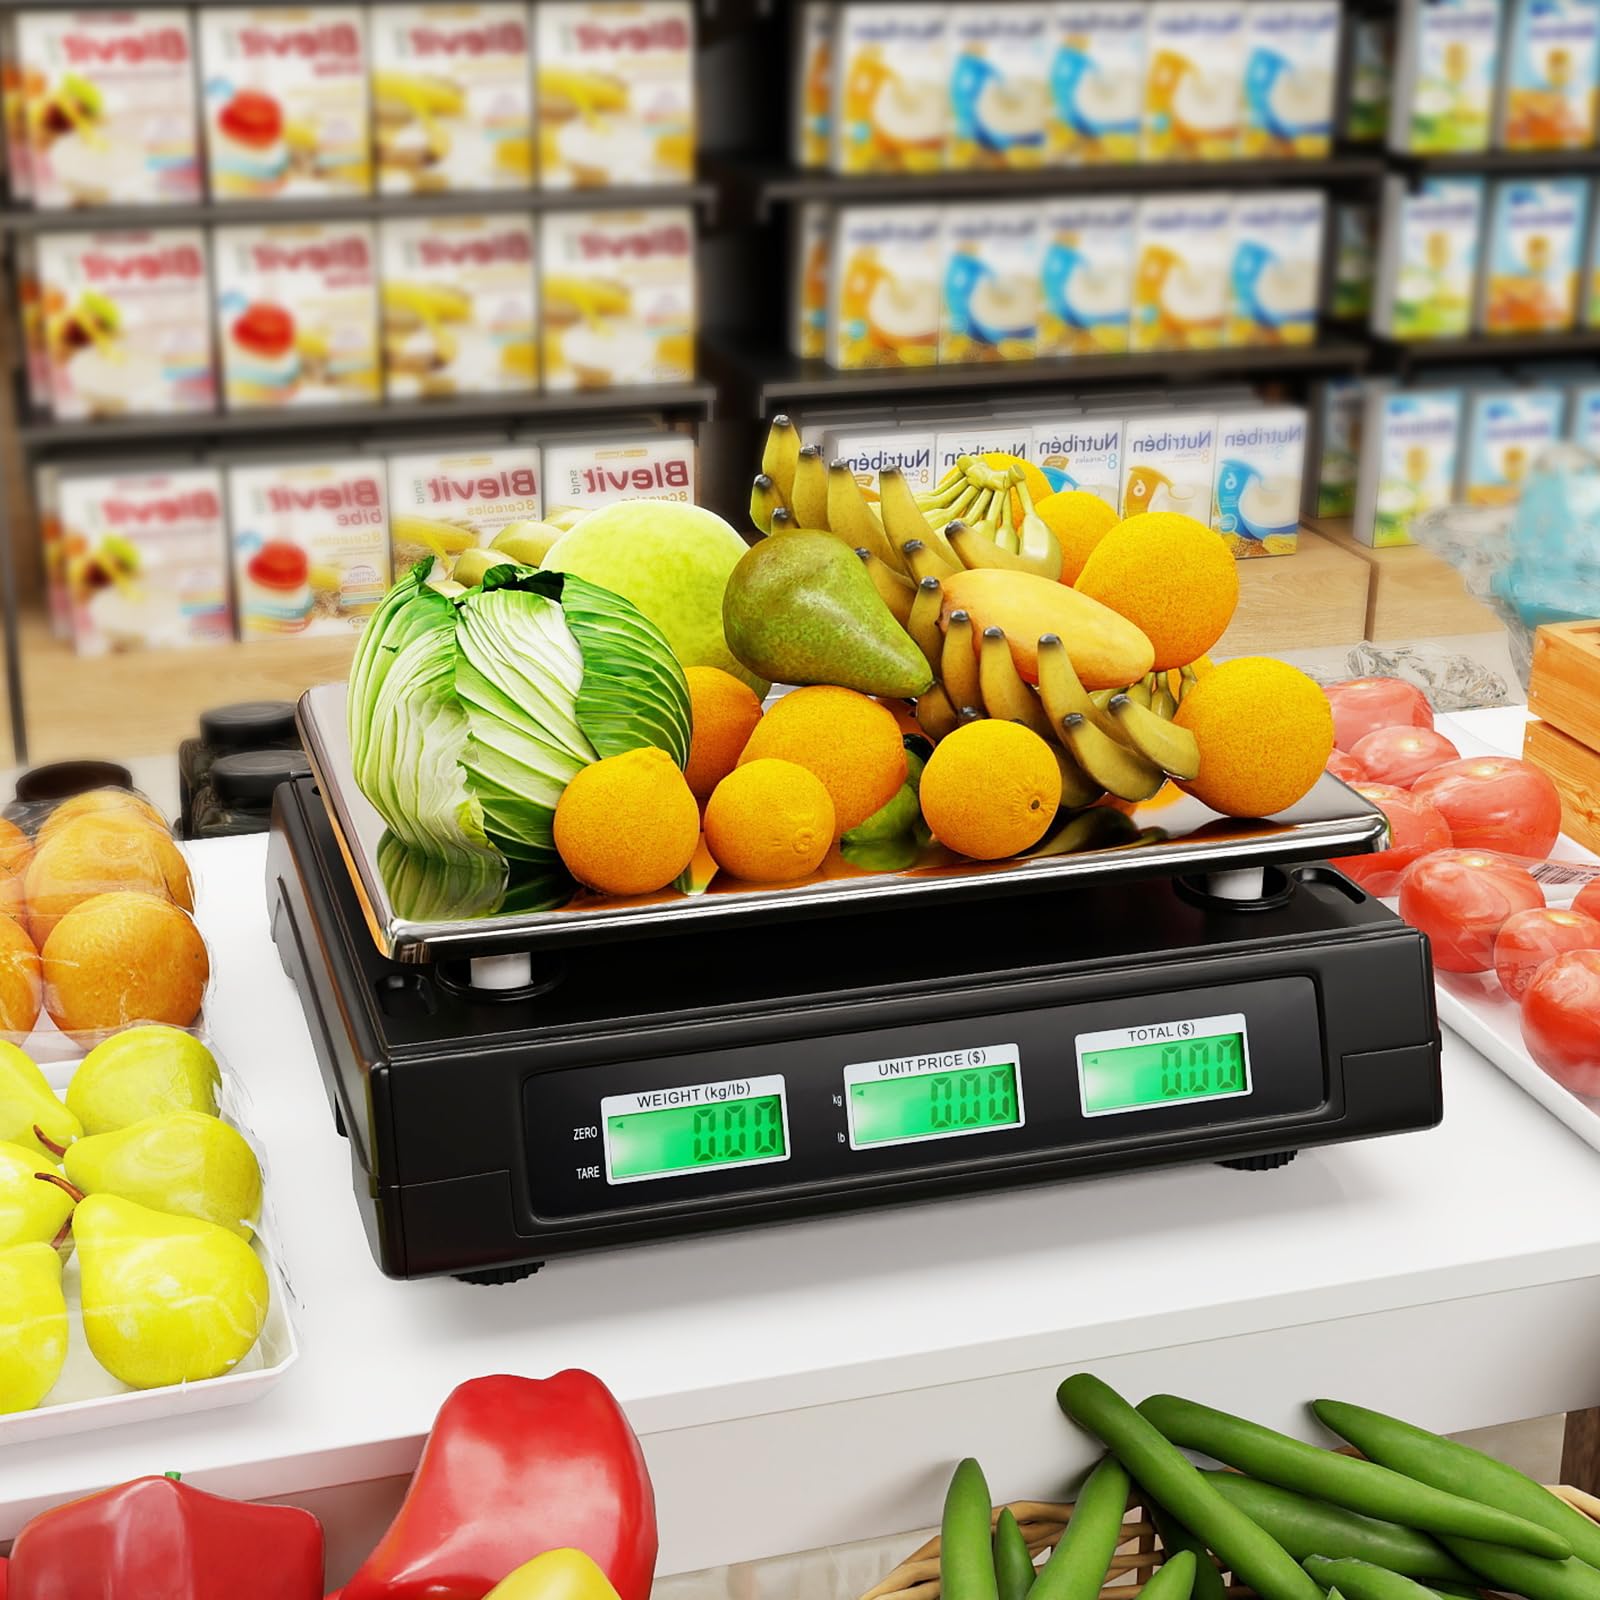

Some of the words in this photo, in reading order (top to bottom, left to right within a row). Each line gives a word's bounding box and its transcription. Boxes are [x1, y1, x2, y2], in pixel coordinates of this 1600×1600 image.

[1128, 1025, 1174, 1042] TOTAL
[1176, 1021, 1196, 1038] ($)
[878, 1060, 914, 1076] UNIT
[917, 1053, 964, 1071] PRICE
[967, 1049, 987, 1066] ($)
[1161, 1039, 1237, 1096] 0.00
[637, 1088, 701, 1108] WEIGHT
[704, 1081, 751, 1102] (kg/lb)
[832, 1093, 843, 1107] kg
[930, 1069, 1010, 1129] 0.00
[573, 1126, 598, 1141] ZERO
[693, 1101, 776, 1161] 0.00
[837, 1132, 846, 1143] lb
[576, 1165, 600, 1180] TARE
